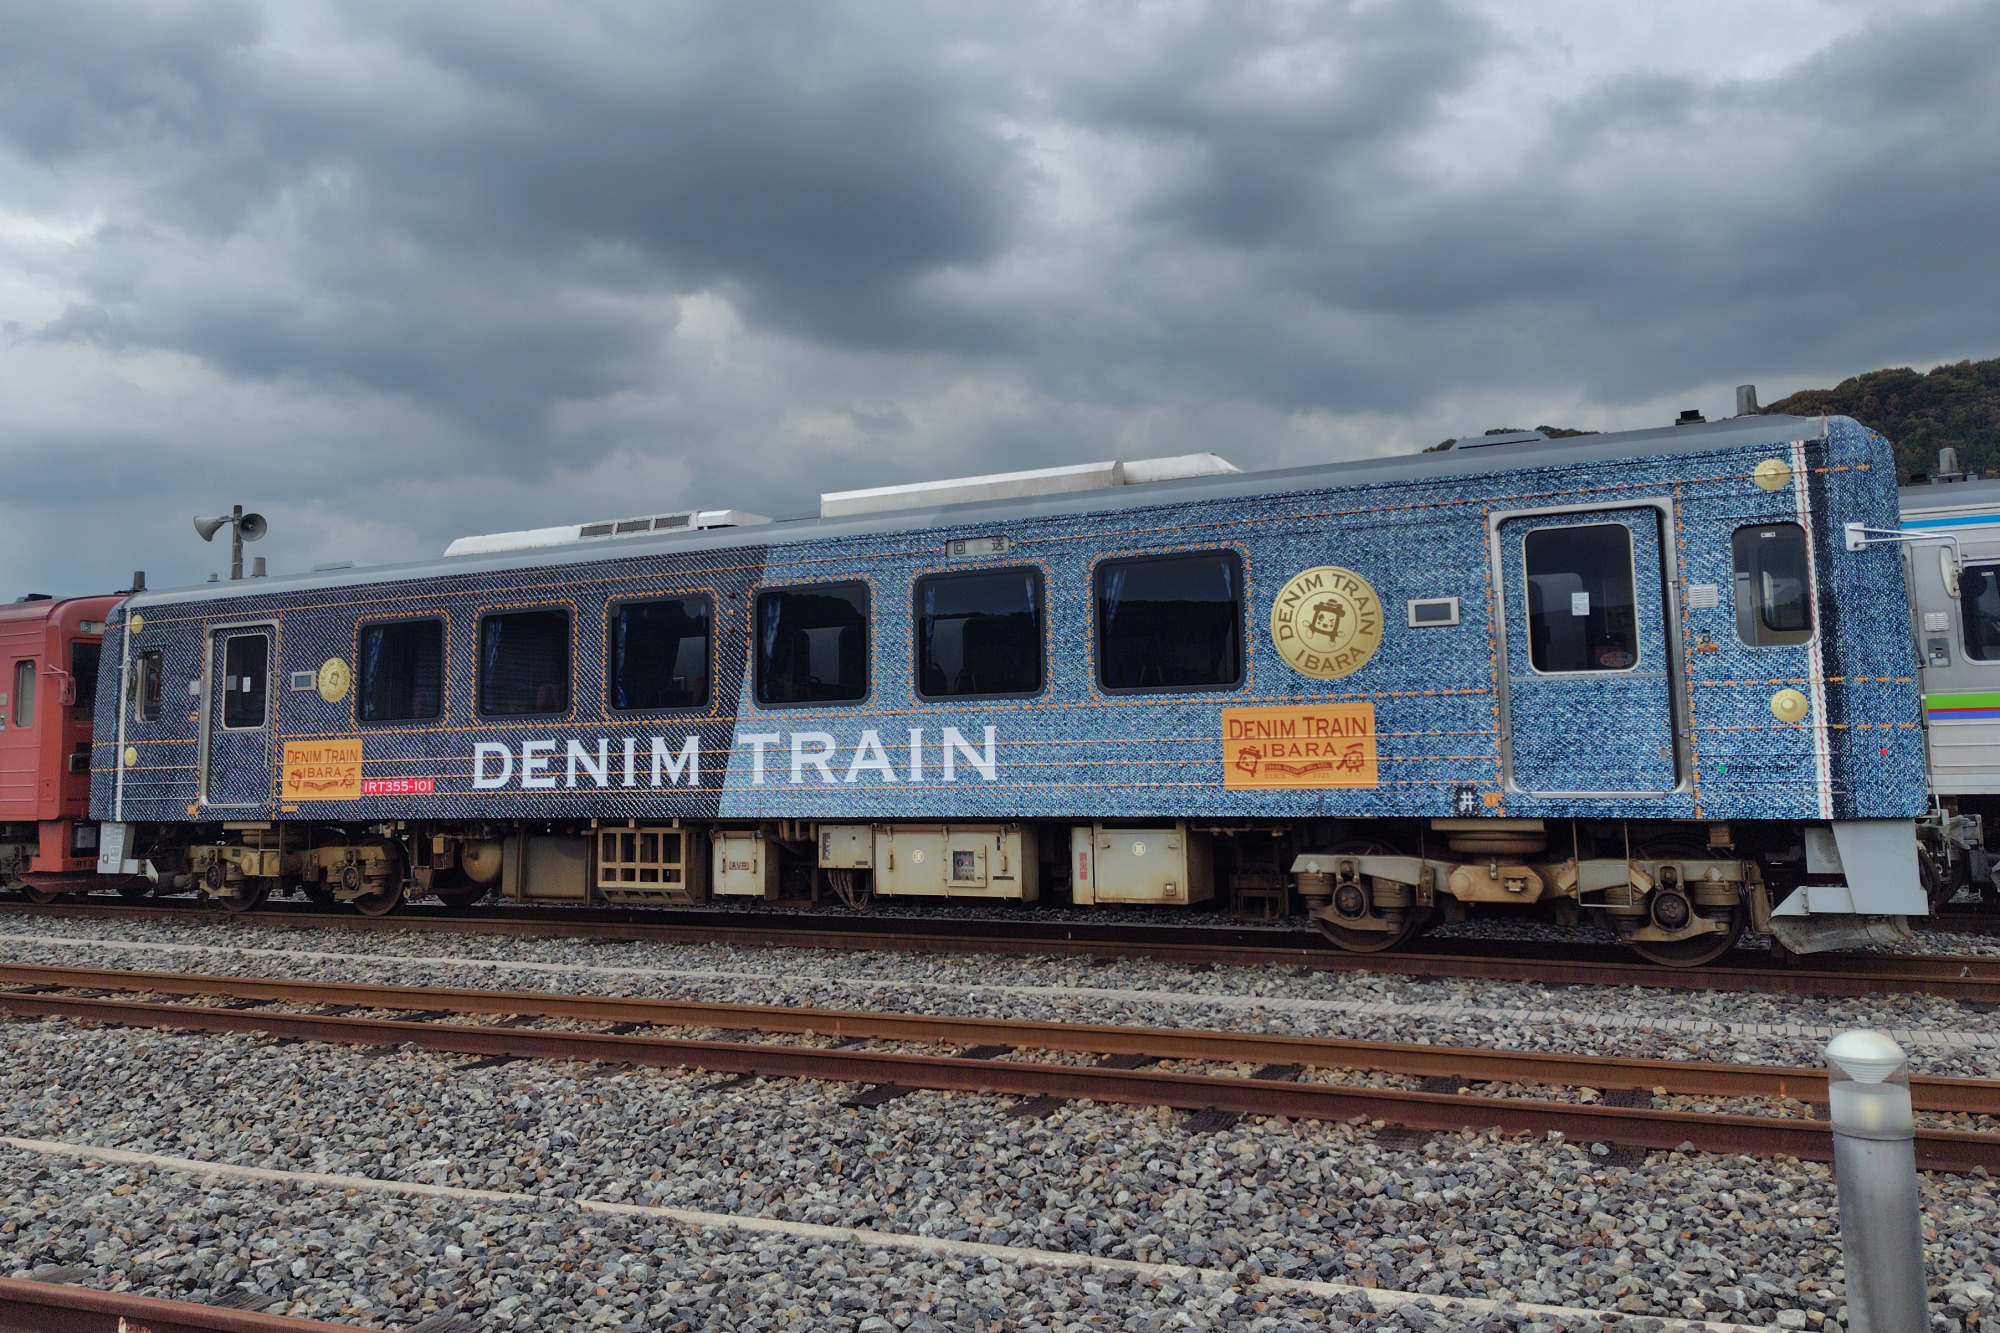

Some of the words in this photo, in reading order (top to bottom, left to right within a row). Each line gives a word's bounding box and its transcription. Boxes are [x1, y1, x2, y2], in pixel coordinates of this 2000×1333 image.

[954, 538, 1004, 555] 回送
[1278, 574, 1323, 641] DENIM
[1332, 573, 1375, 636] TRAIN
[1294, 646, 1366, 672] IBARA
[321, 661, 335, 687] DENIM
[337, 661, 348, 686] TRAIN
[1229, 719, 1296, 739] DENIM
[1302, 716, 1367, 738] TRAIN
[287, 750, 321, 764] DENIM
[325, 748, 358, 763] TRAIN
[472, 736, 700, 789] DENIM
[738, 726, 998, 785] TRAIN
[1262, 742, 1337, 758] IBARA
[303, 767, 341, 778] IBARA
[364, 781, 432, 792] IRT355-101
[731, 861, 747, 869] AVR
